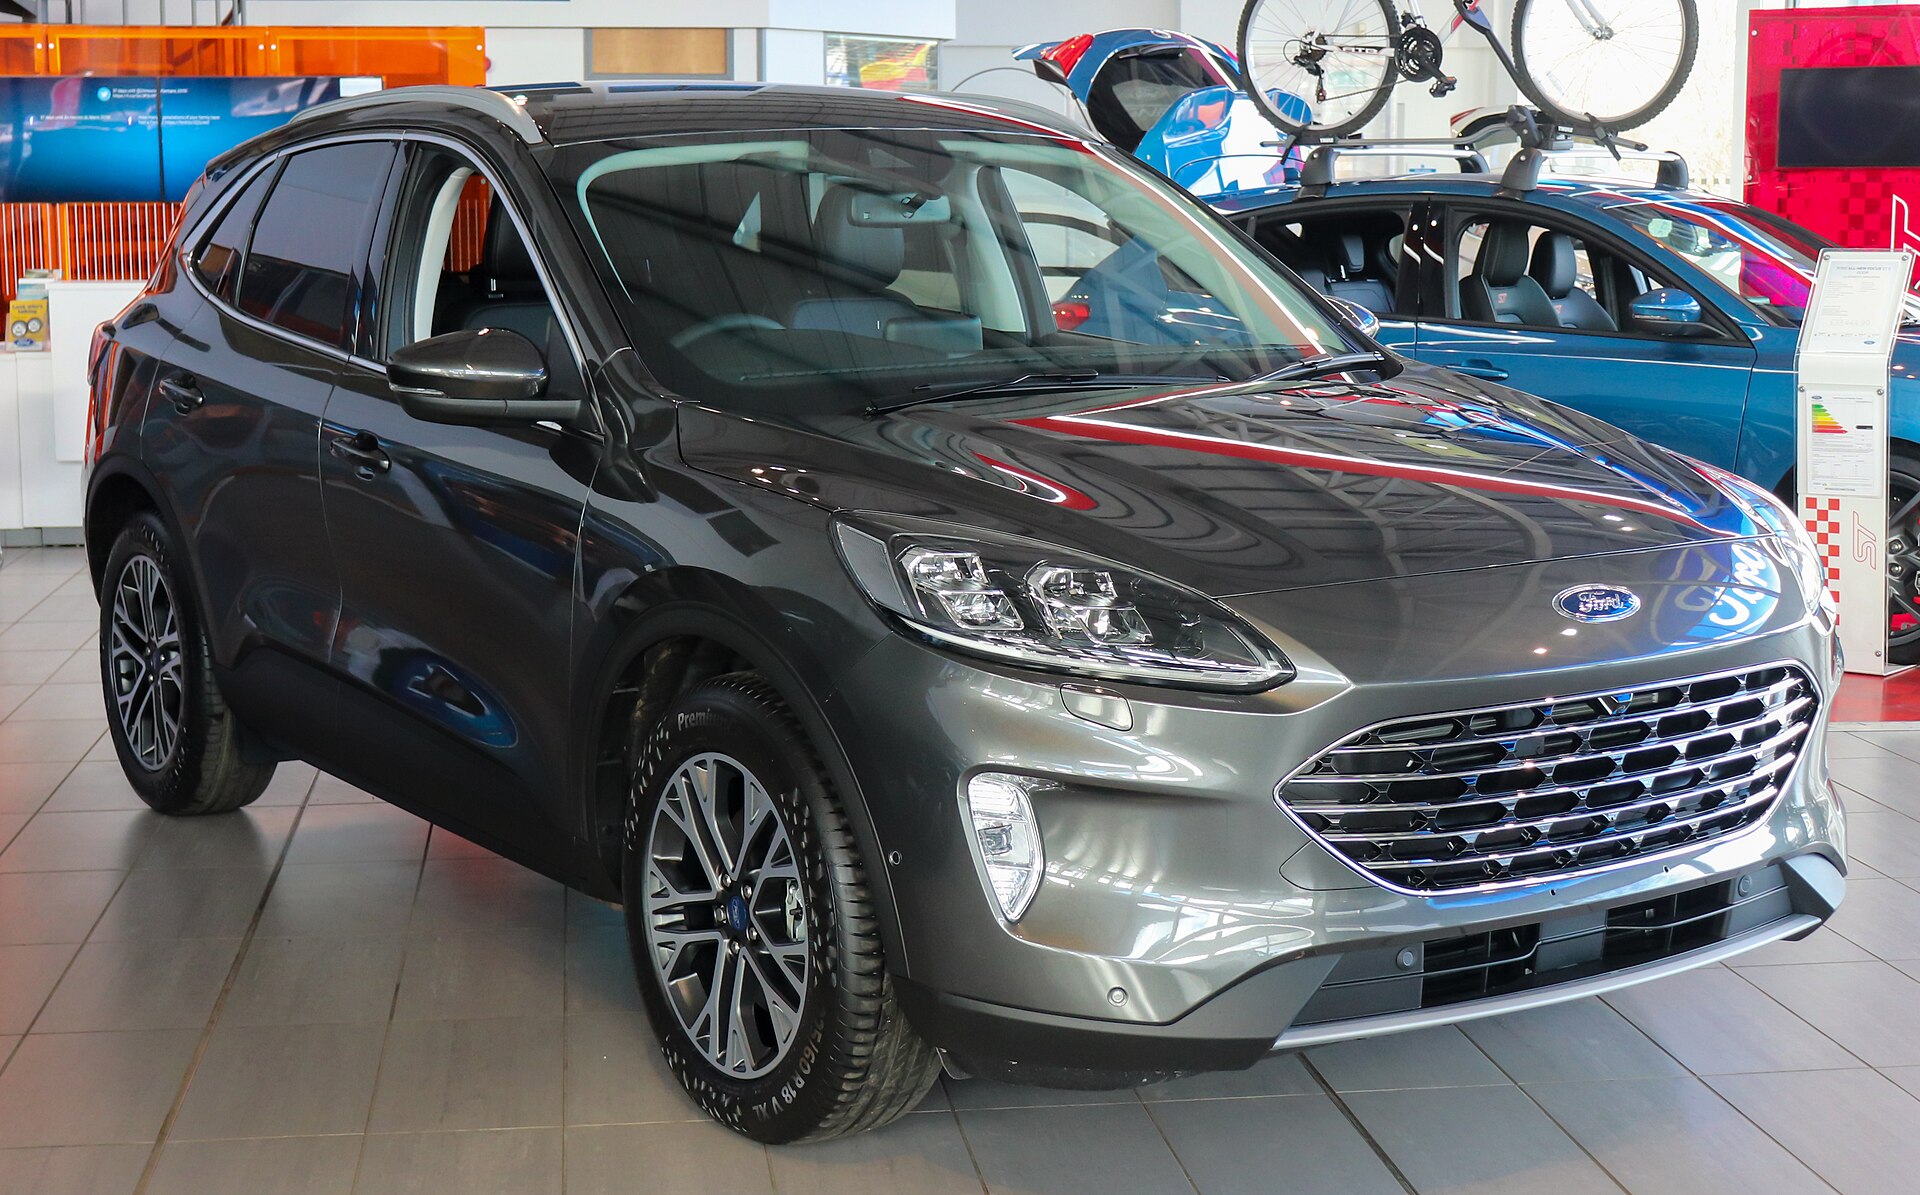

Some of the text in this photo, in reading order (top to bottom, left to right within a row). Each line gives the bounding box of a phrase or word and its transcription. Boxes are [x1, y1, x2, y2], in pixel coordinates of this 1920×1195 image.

[1853, 510, 1877, 570] ST
[1578, 591, 1628, 613] Ford
[781, 1083, 797, 1104] 18
[752, 1102, 771, 1121] XL
[771, 1096, 784, 1116] V
